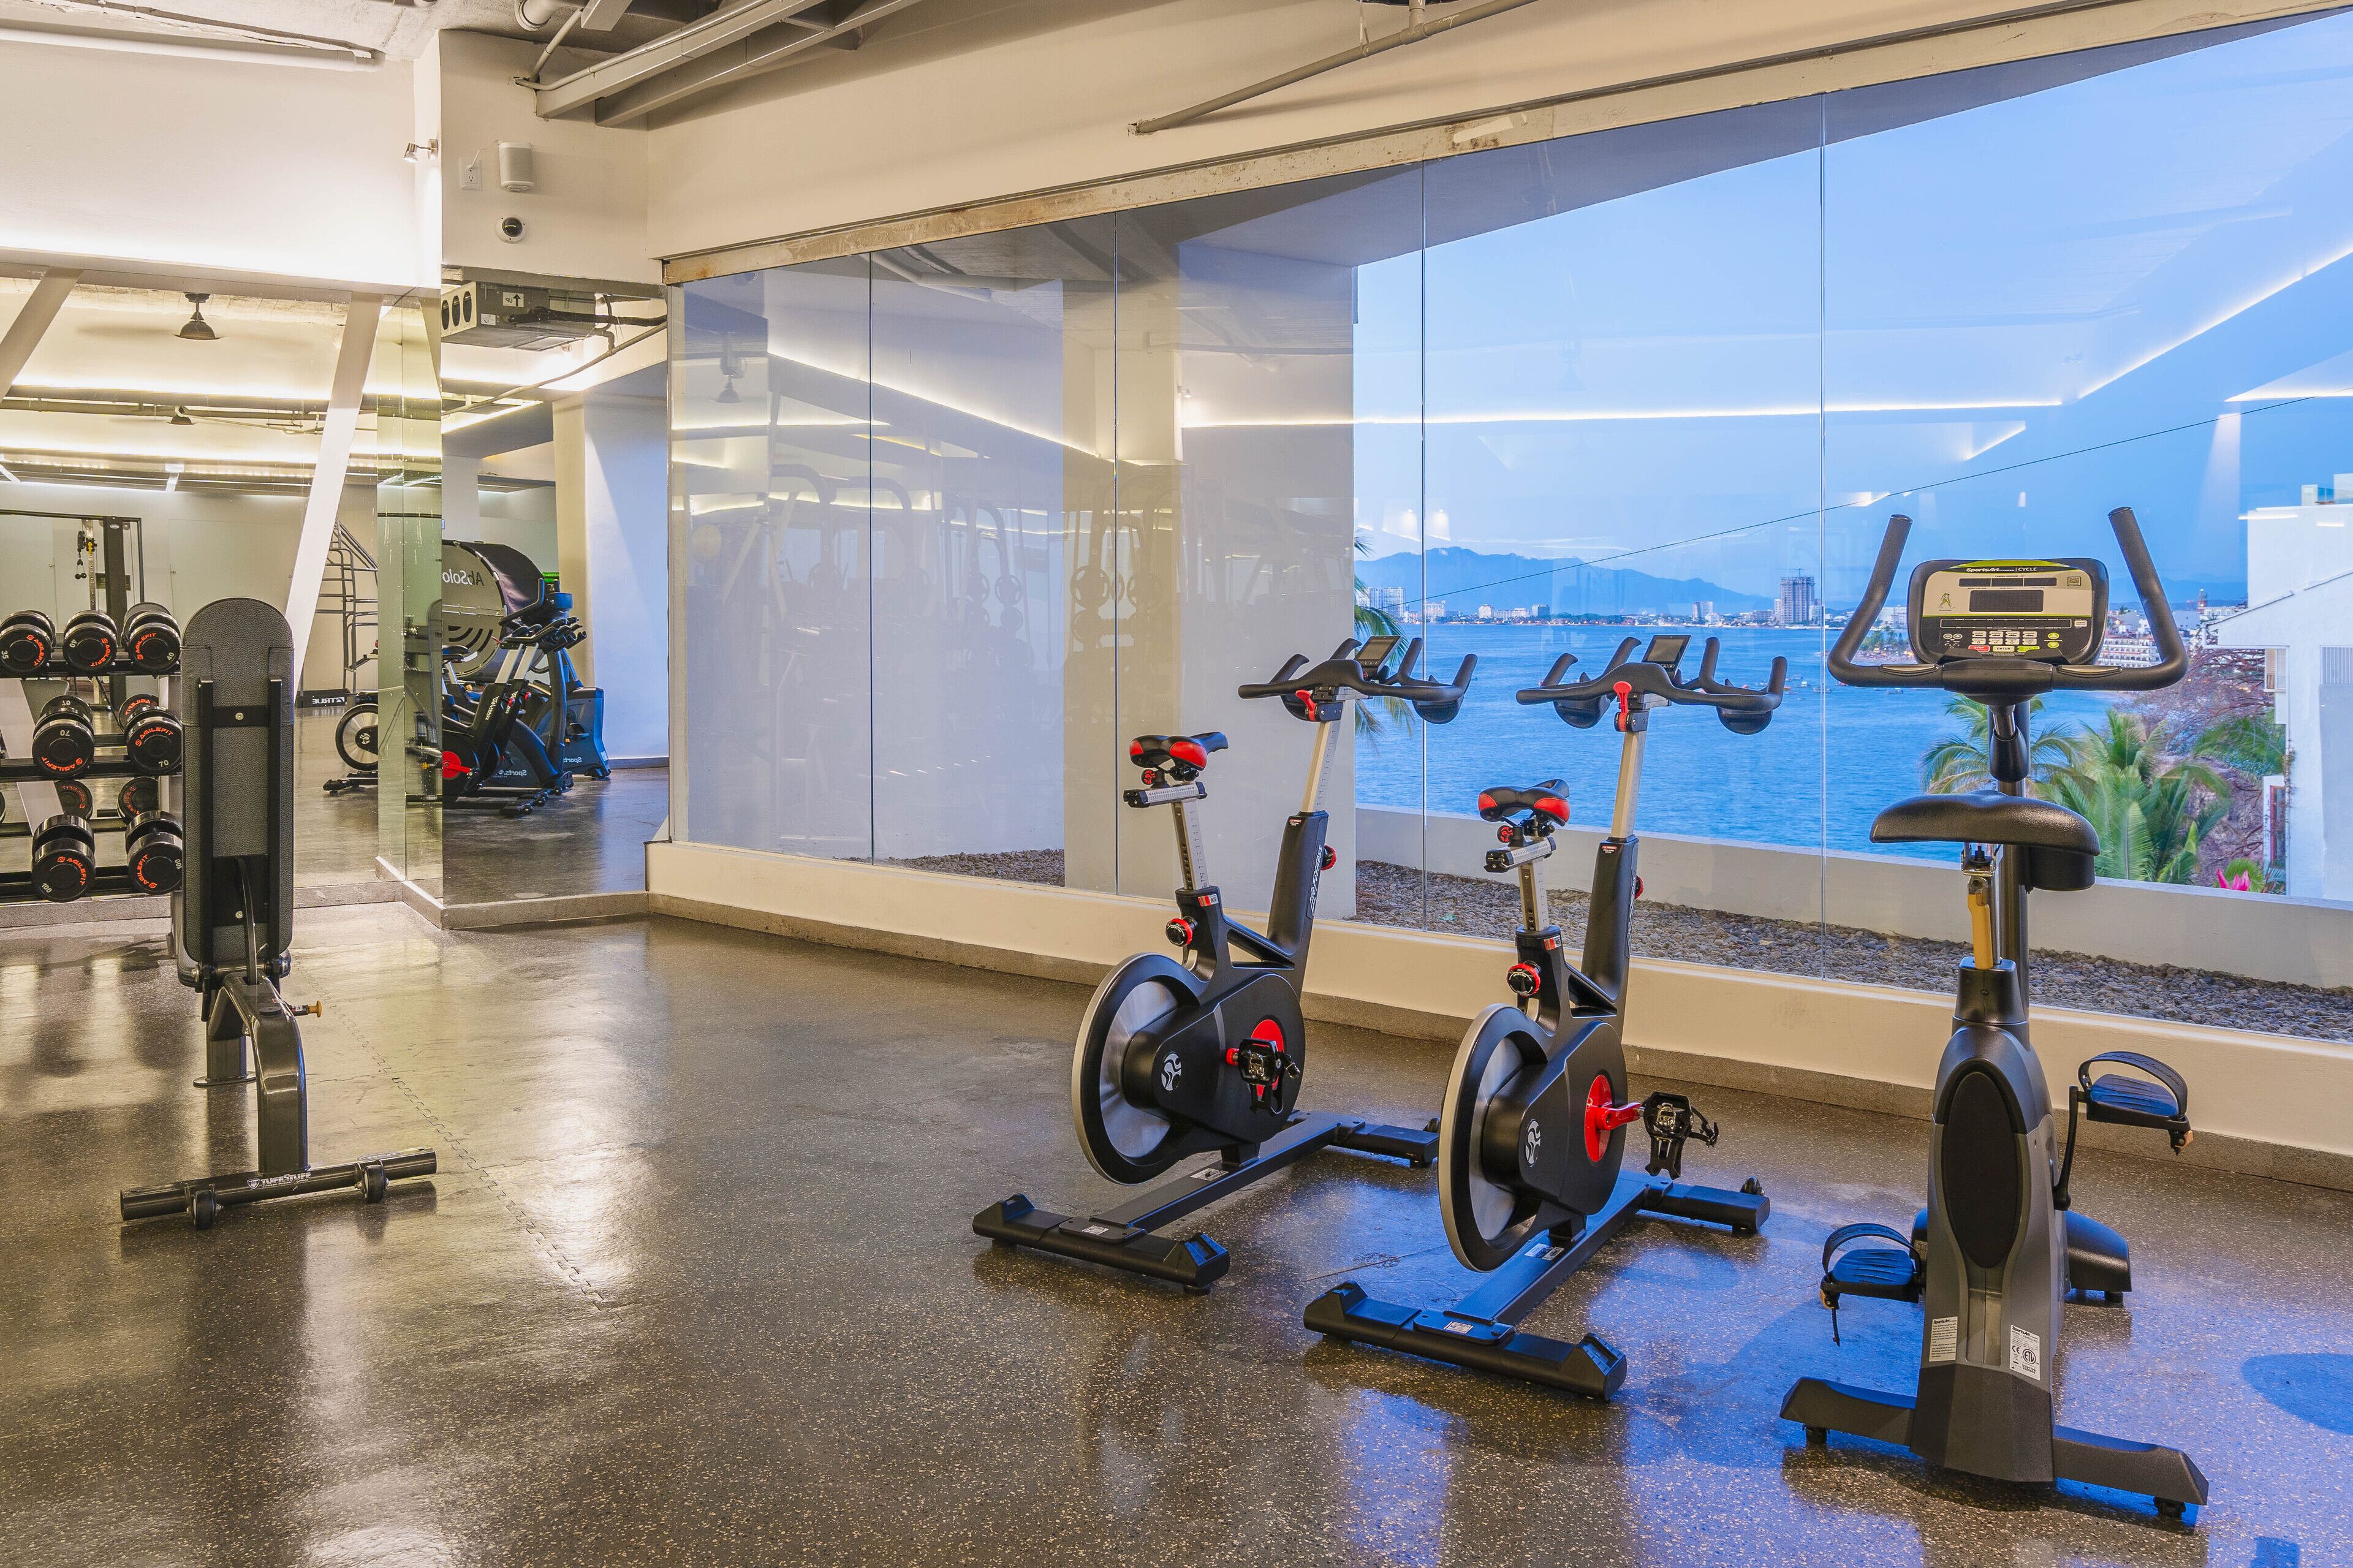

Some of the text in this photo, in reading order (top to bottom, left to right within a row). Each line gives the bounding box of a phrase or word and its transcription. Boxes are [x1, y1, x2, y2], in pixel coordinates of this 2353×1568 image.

[69, 639, 77, 648] 40
[135, 632, 157, 654] AGILEFIT
[1, 650, 9, 659] 35
[33, 638, 45, 667] AGILEFIT
[90, 644, 110, 667] AGILEFIT
[167, 652, 175, 661] 40
[140, 727, 174, 740] AGILEFIT
[42, 757, 76, 771] AGILEFIT
[137, 854, 149, 885] AGILEFIT
[175, 858, 183, 869] 100
[66, 857, 86, 886] AGILEFIT
[41, 882, 53, 893] 100
[2012, 1345, 2020, 1354] CE
